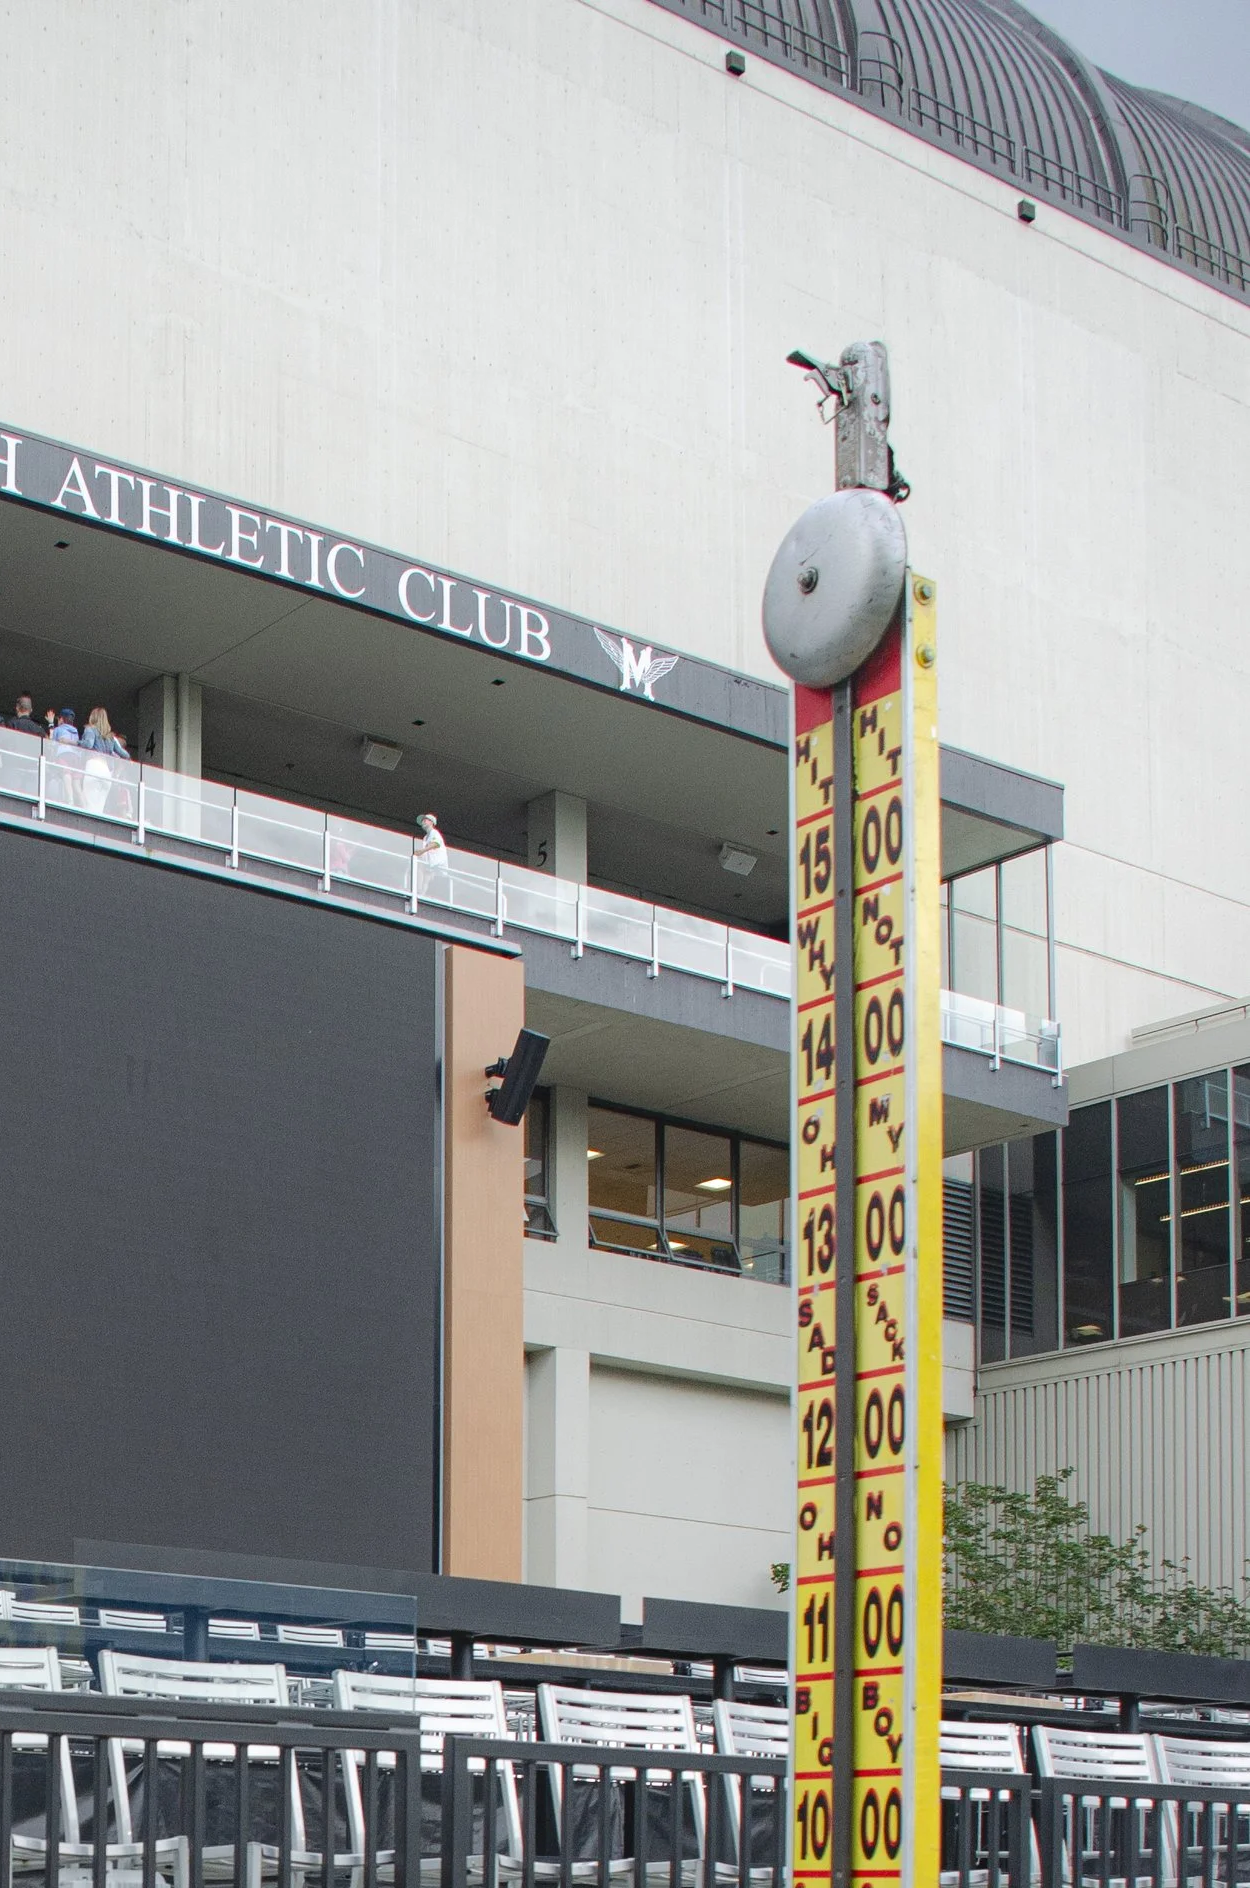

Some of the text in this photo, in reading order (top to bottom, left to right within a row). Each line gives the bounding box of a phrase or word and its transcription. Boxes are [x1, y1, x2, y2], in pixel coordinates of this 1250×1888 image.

[51, 456, 366, 600] ATHLETIC
[398, 567, 551, 663] CLUB
[796, 706, 902, 805] HIT HIT
[537, 840, 547, 867] 5
[800, 796, 903, 899] 15 00
[797, 894, 904, 991] WHY NOT
[802, 988, 904, 1086] 14 00
[802, 1094, 904, 1172] OH MY
[803, 1185, 905, 1276] 13 00
[798, 1284, 904, 1375] SAD SACK
[803, 1383, 905, 1469] 12 00
[800, 1491, 902, 1561] OH NO
[804, 1584, 904, 1663] 11 00
[795, 1681, 902, 1766] BIG BOY
[797, 1787, 902, 1860] 10 00
